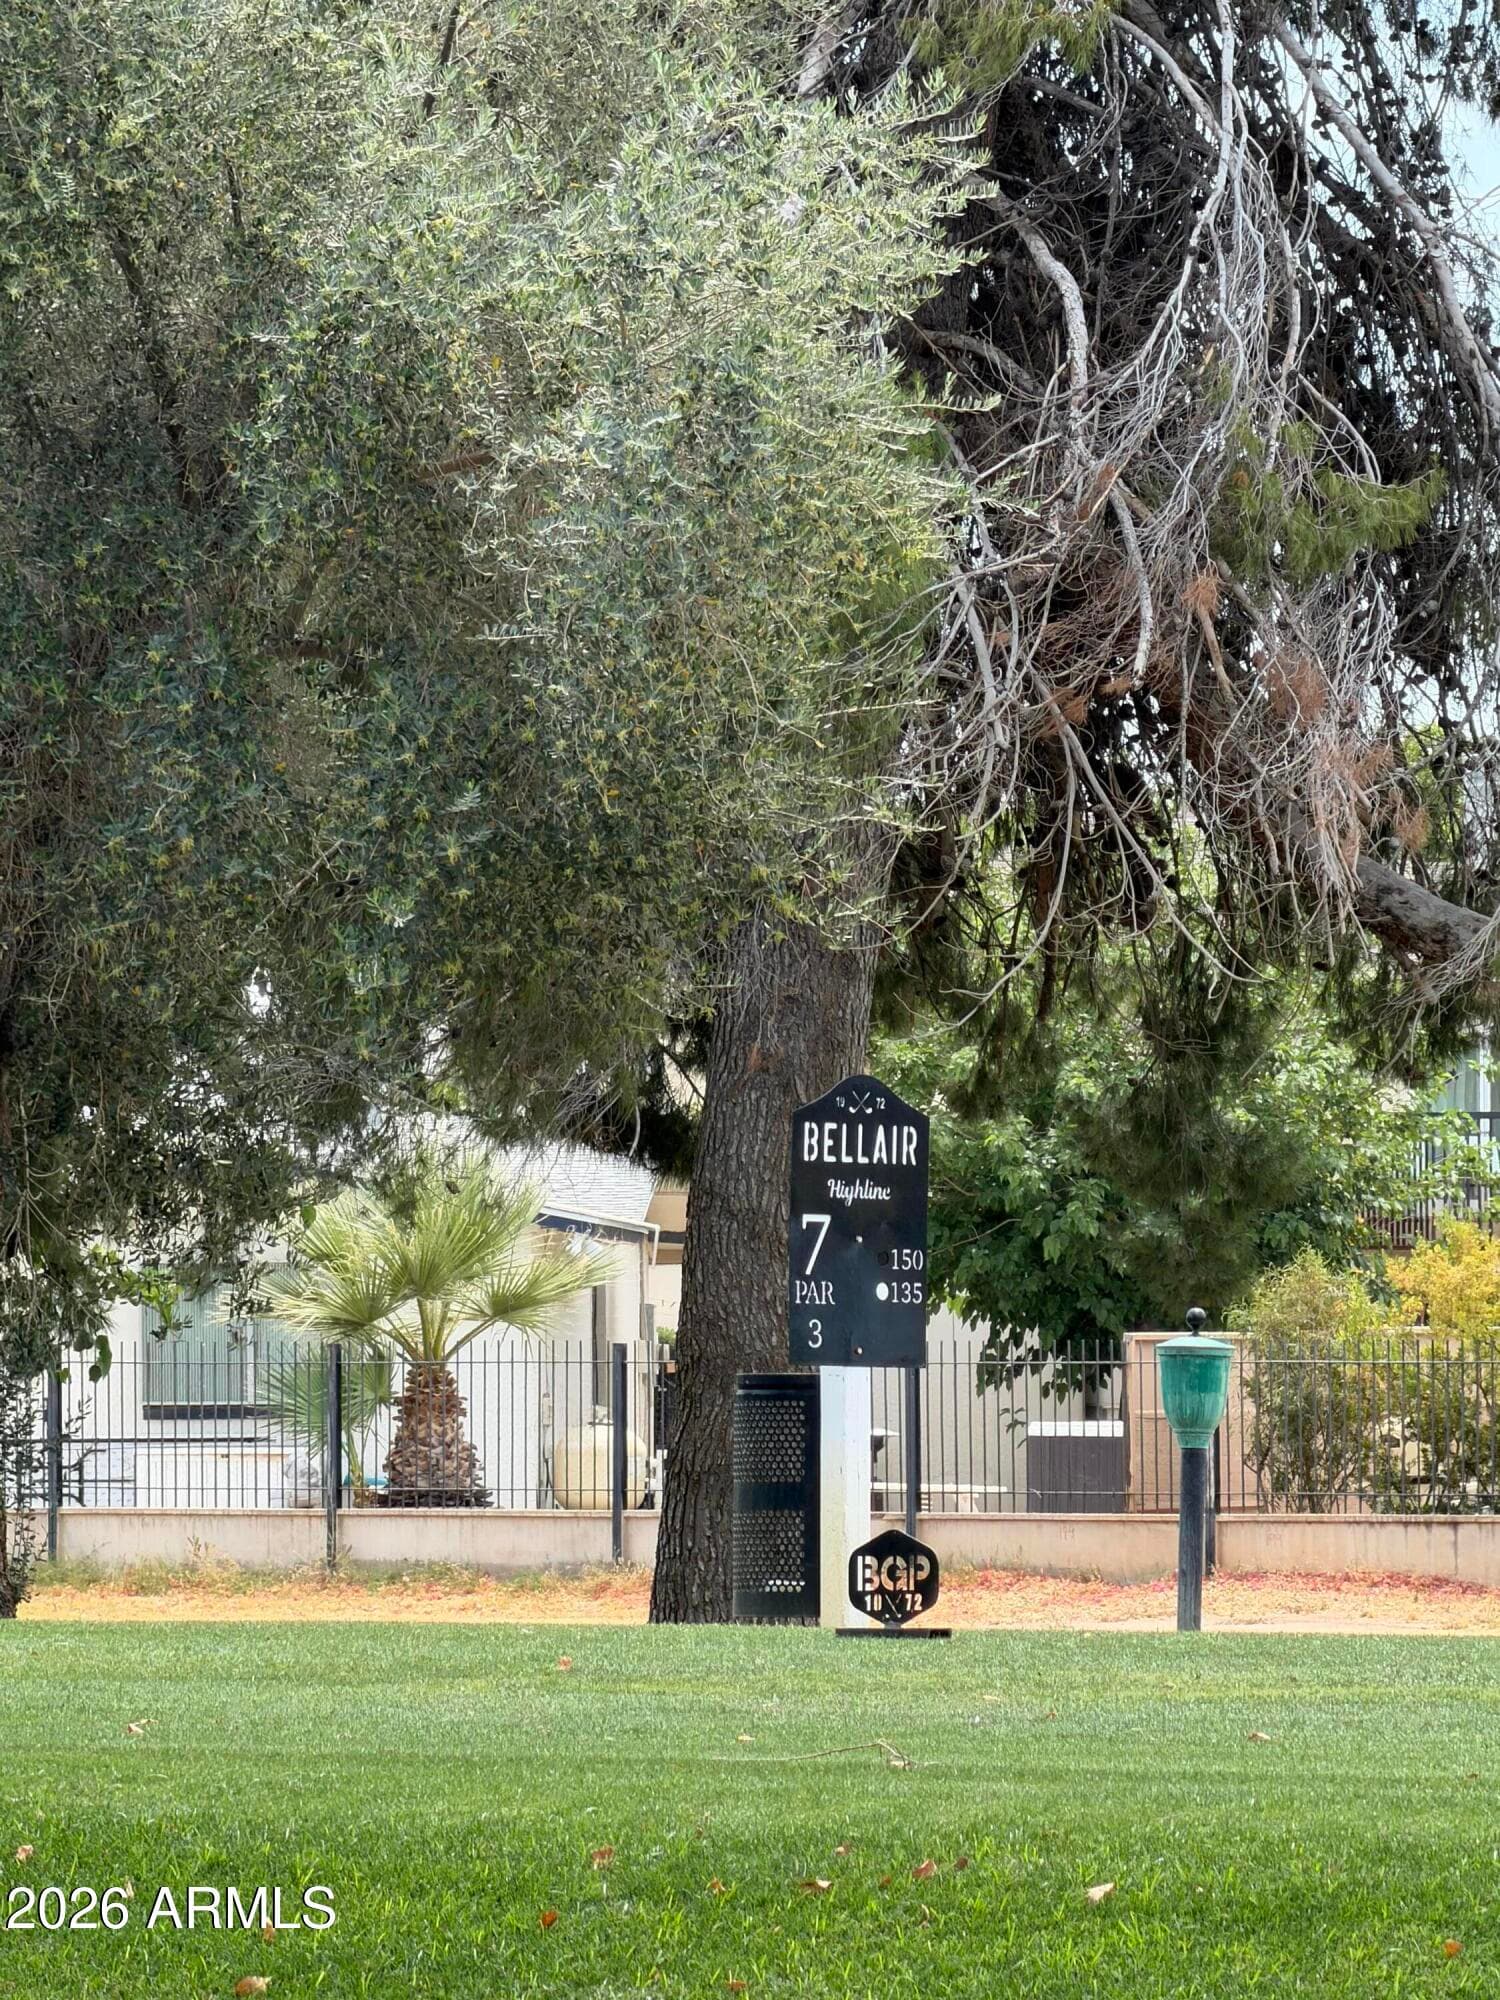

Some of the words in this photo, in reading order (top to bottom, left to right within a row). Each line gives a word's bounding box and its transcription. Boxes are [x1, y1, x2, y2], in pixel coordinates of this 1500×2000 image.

[876, 1097, 886, 1110] 72
[803, 1121, 918, 1166] BELLAIR
[827, 1178, 891, 1207] Highline
[801, 1213, 832, 1276] 7
[891, 1249, 924, 1270] 150
[795, 1280, 836, 1305] PAR
[891, 1282, 923, 1304] 135
[808, 1318, 823, 1349] 3
[857, 1555, 931, 1592] BGP
[905, 1593, 923, 1611] 72
